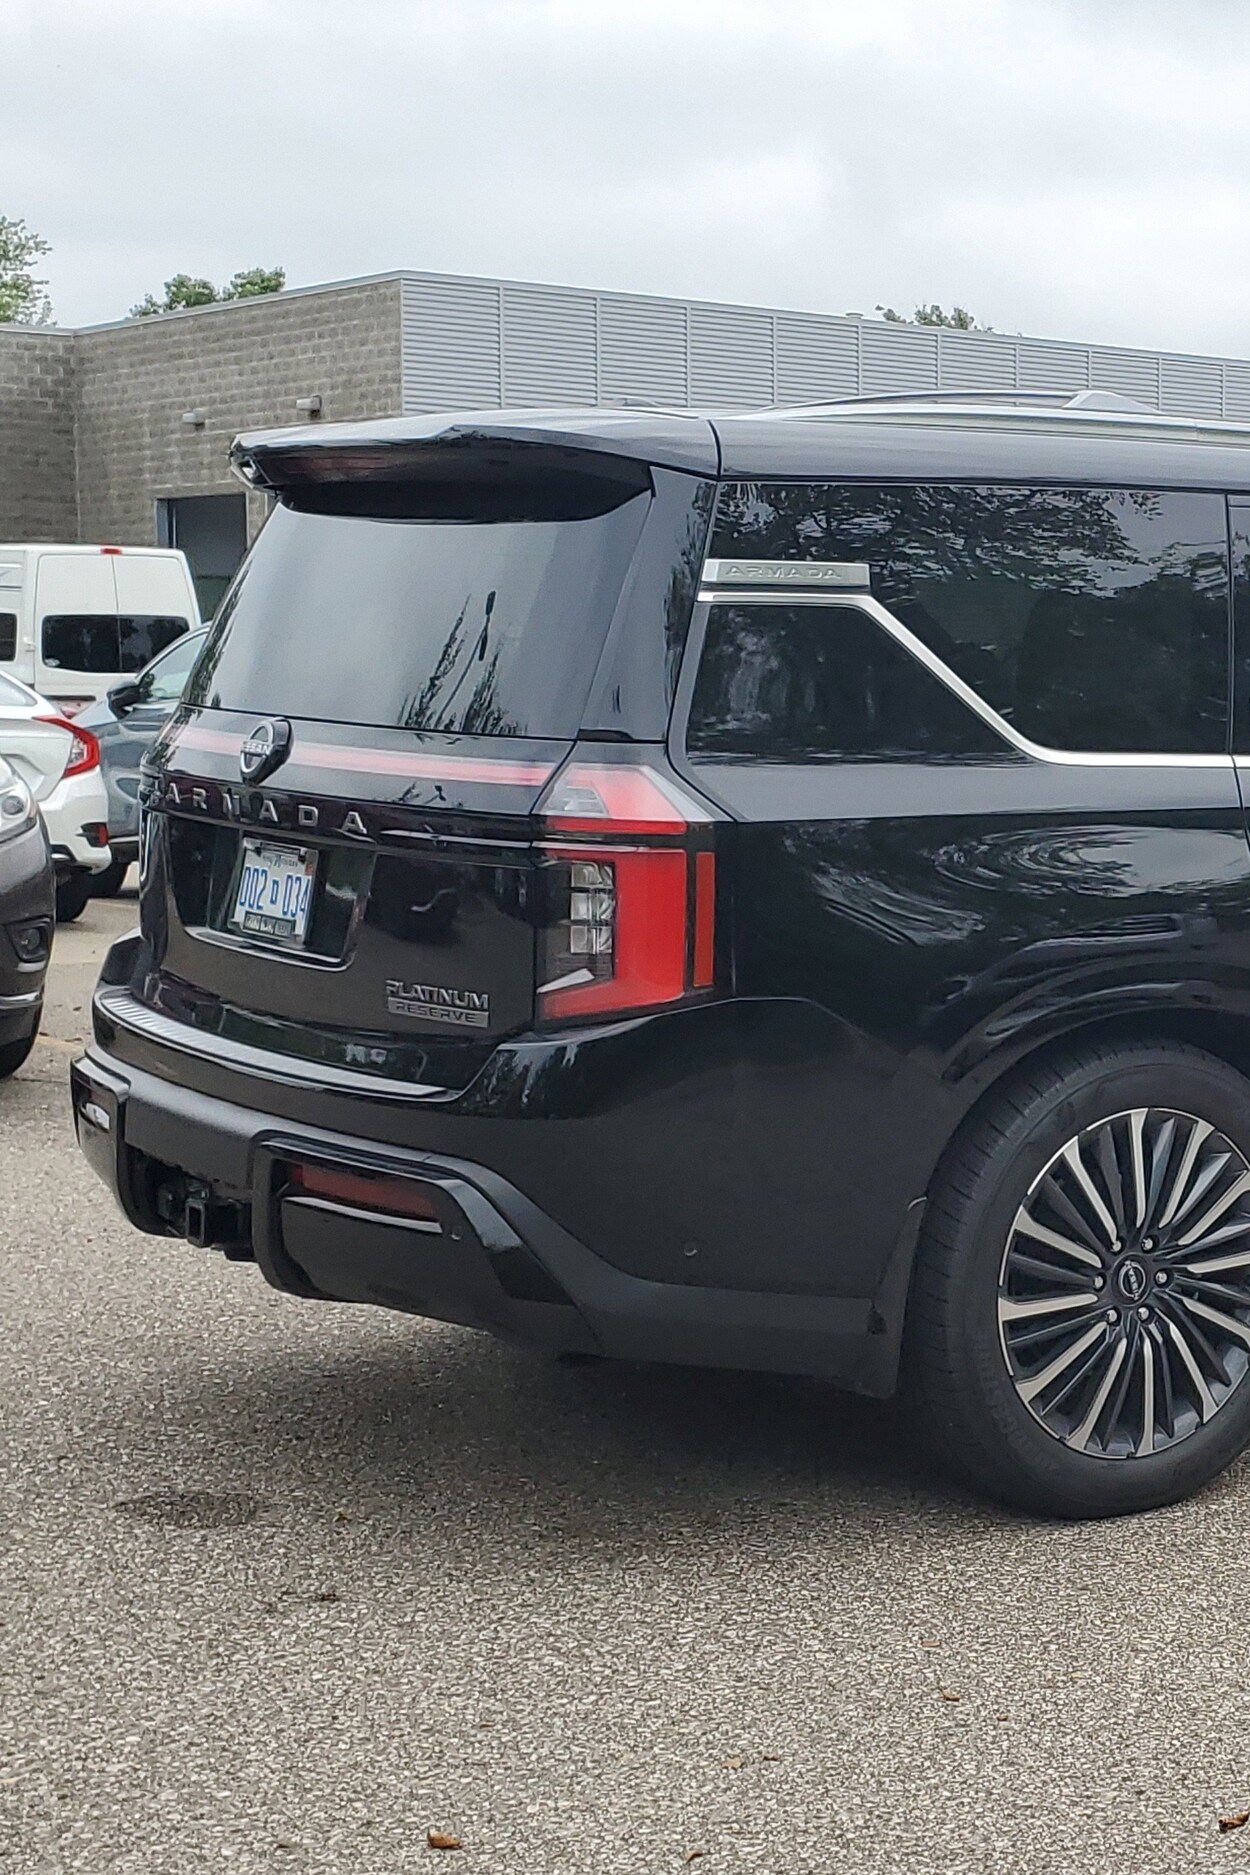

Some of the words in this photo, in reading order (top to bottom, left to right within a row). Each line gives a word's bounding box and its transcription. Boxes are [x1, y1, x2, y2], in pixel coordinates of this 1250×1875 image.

[725, 565, 842, 580] ARMADA
[241, 741, 273, 755] SSAN
[166, 782, 368, 834] ARMADA
[239, 865, 268, 911] 002
[282, 874, 312, 919] 034
[385, 980, 489, 1010] PLATINUM
[395, 1001, 478, 1023] RESERVE
